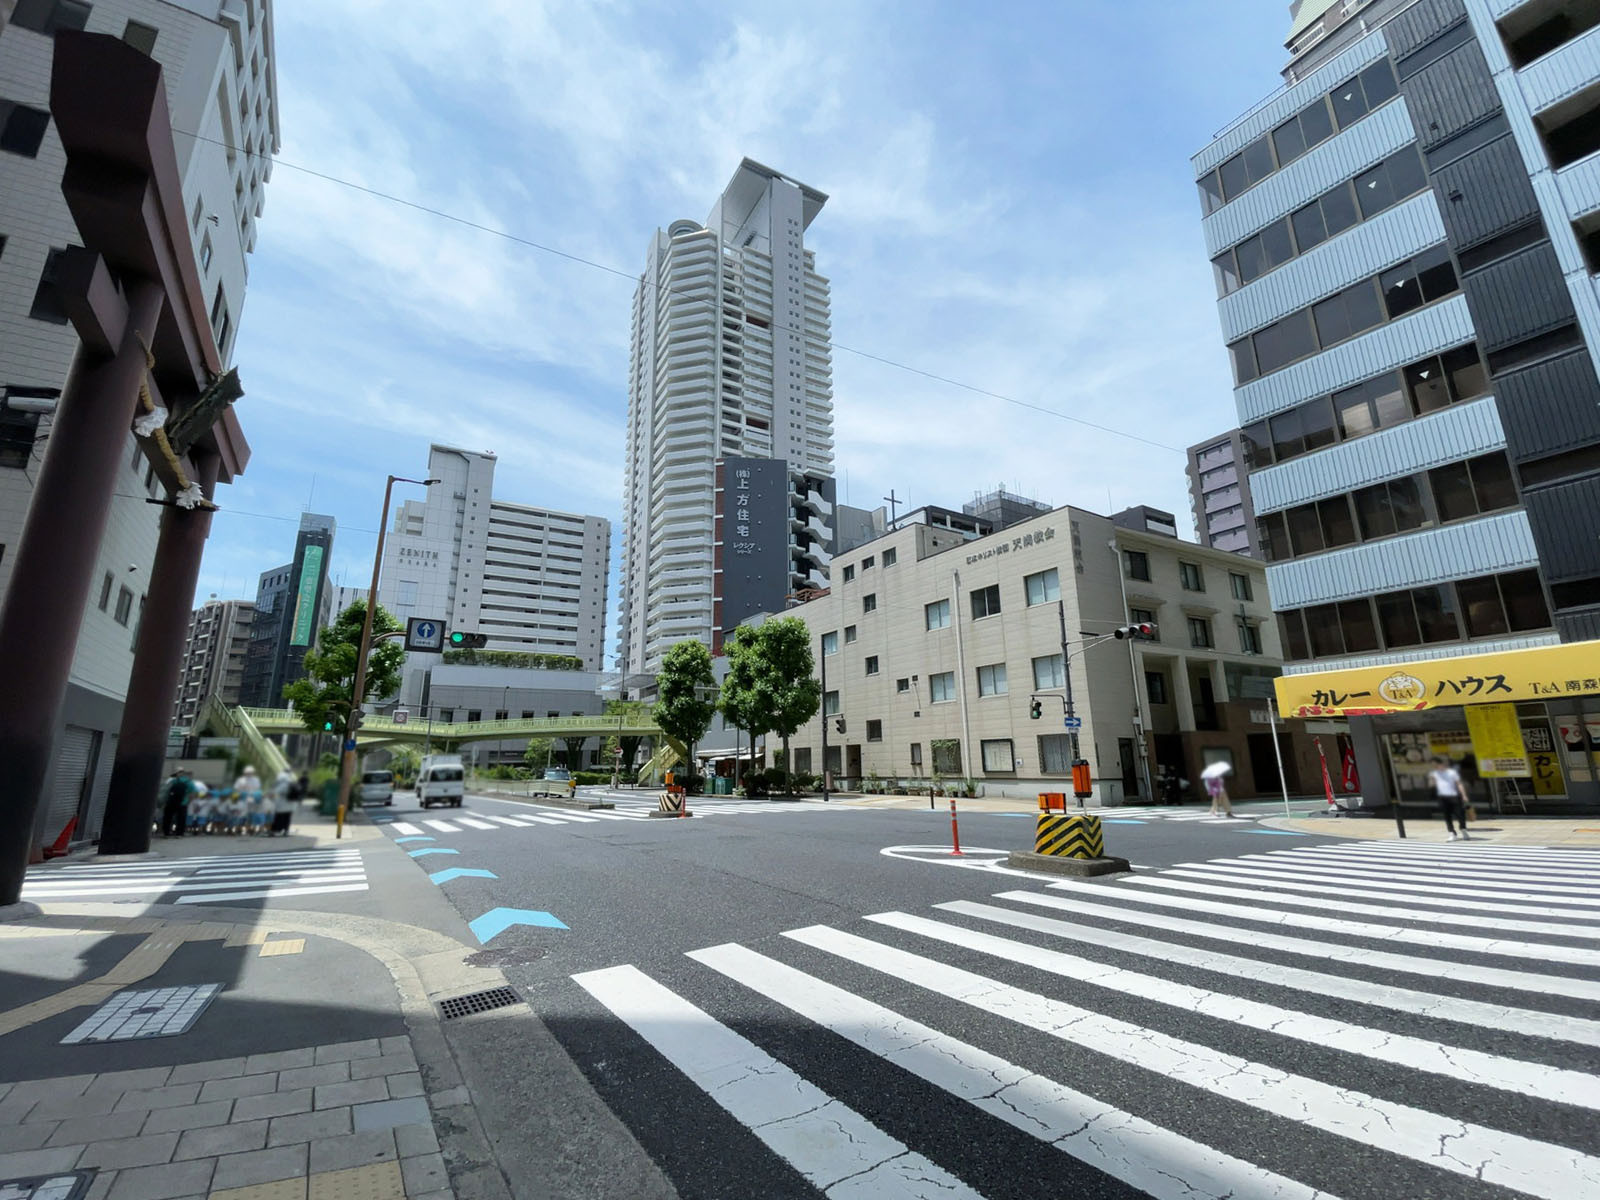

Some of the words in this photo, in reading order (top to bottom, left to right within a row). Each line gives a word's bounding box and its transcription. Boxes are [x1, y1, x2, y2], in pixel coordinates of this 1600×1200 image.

[400, 547, 439, 560] ZENITH
[1312, 689, 1371, 707] カレー
[1434, 674, 1513, 697] ハウス
[1528, 681, 1561, 695] T&A
[1564, 677, 1600, 692] 南森
